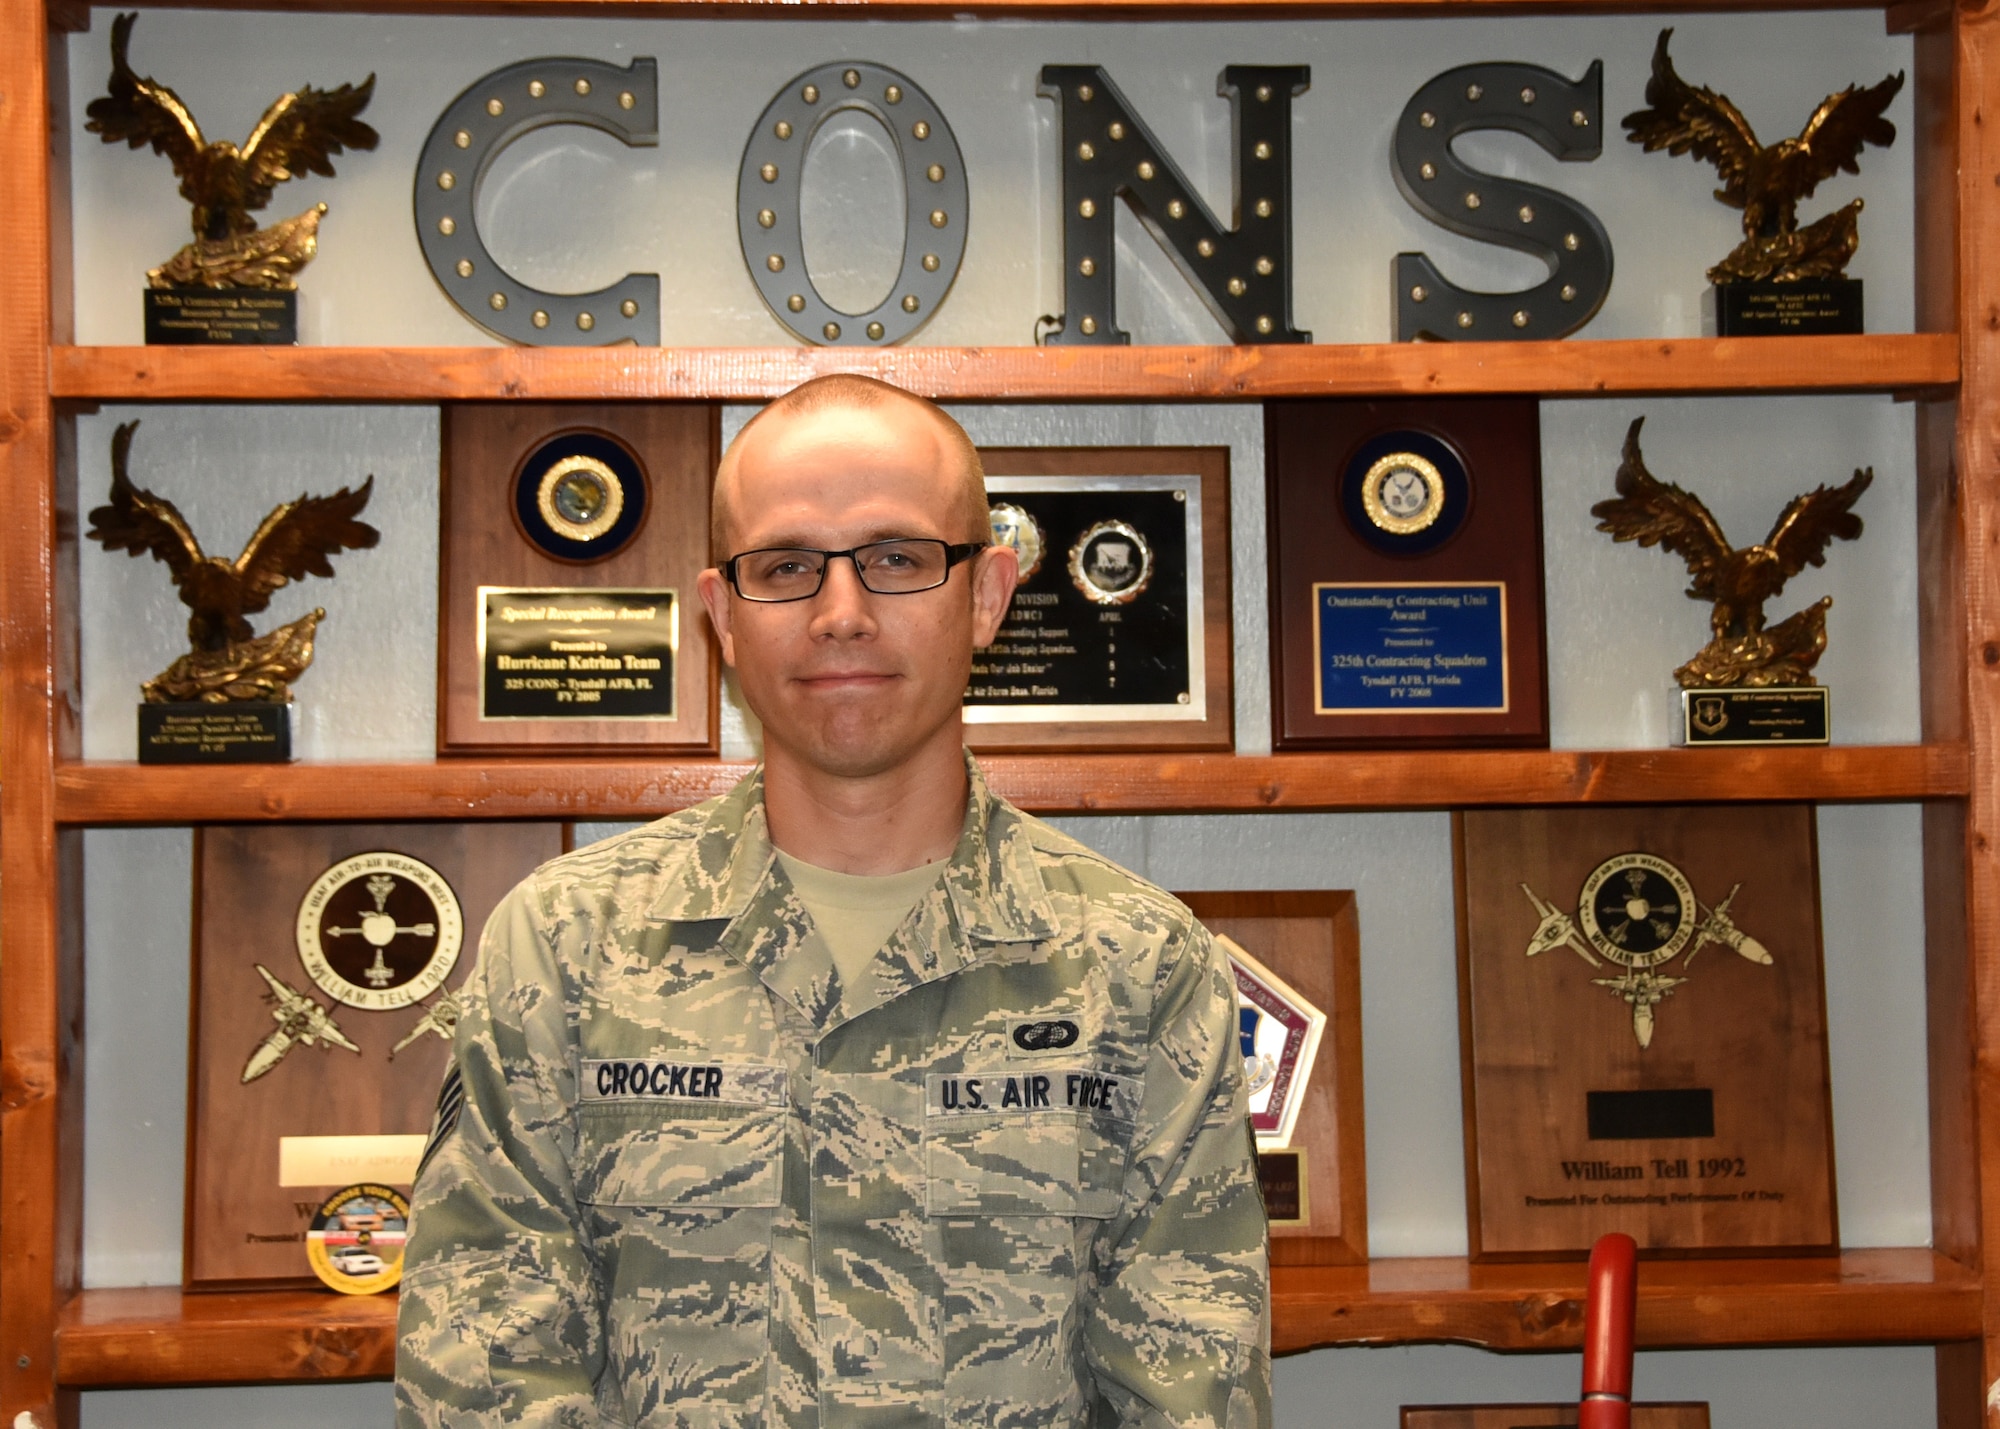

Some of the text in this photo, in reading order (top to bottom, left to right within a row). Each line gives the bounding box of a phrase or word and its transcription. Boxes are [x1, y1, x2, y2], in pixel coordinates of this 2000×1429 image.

[413, 56, 1615, 346] CONS
[1015, 593, 1059, 606] DIVISION
[1327, 595, 1487, 608] Outstanding Contracting Unit
[501, 607, 656, 623] Special Recognition Award
[1098, 612, 1122, 622] APRIL
[1390, 609, 1426, 621] Award
[1038, 627, 1069, 638] Support
[551, 641, 608, 652] Presented to
[1108, 643, 1116, 654] 9
[1384, 638, 1434, 647] Presented to
[1012, 644, 1038, 656] Supply
[497, 655, 661, 670] Hurricane Katrina Team
[1332, 654, 1487, 669] 325th Contracting Squadron
[1006, 663, 1021, 674] Job
[505, 678, 524, 689] 325
[526, 678, 559, 689] CONS
[568, 678, 606, 691] Tyndall
[608, 678, 635, 690] AFB,
[1360, 675, 1396, 687] Tyndall
[1427, 675, 1461, 685] Florida
[557, 691, 574, 702] FY
[1031, 685, 1059, 696] Florida
[1390, 688, 1404, 698] FY
[1751, 694, 1788, 702] Contracting
[1790, 693, 1822, 702] Squadron
[250, 733, 276, 742] Award
[1640, 857, 1676, 878] WEAPONS
[1674, 876, 1689, 894] MEET
[311, 858, 450, 907] USAF AIR-TO-AIR WEAPONS MEET
[1591, 928, 1689, 965] WILLIAM TELL 1992
[311, 955, 450, 1006] WILLIAM TELL 1990
[597, 1062, 723, 1097] CROCKER
[942, 1079, 989, 1110] U.S.
[1001, 1075, 1050, 1108] AIR
[1561, 1157, 1746, 1181] William Tell 1992
[1524, 1190, 1785, 1207] Presented For Outstanding Performance Of Duty
[246, 1232, 299, 1244] Presented
